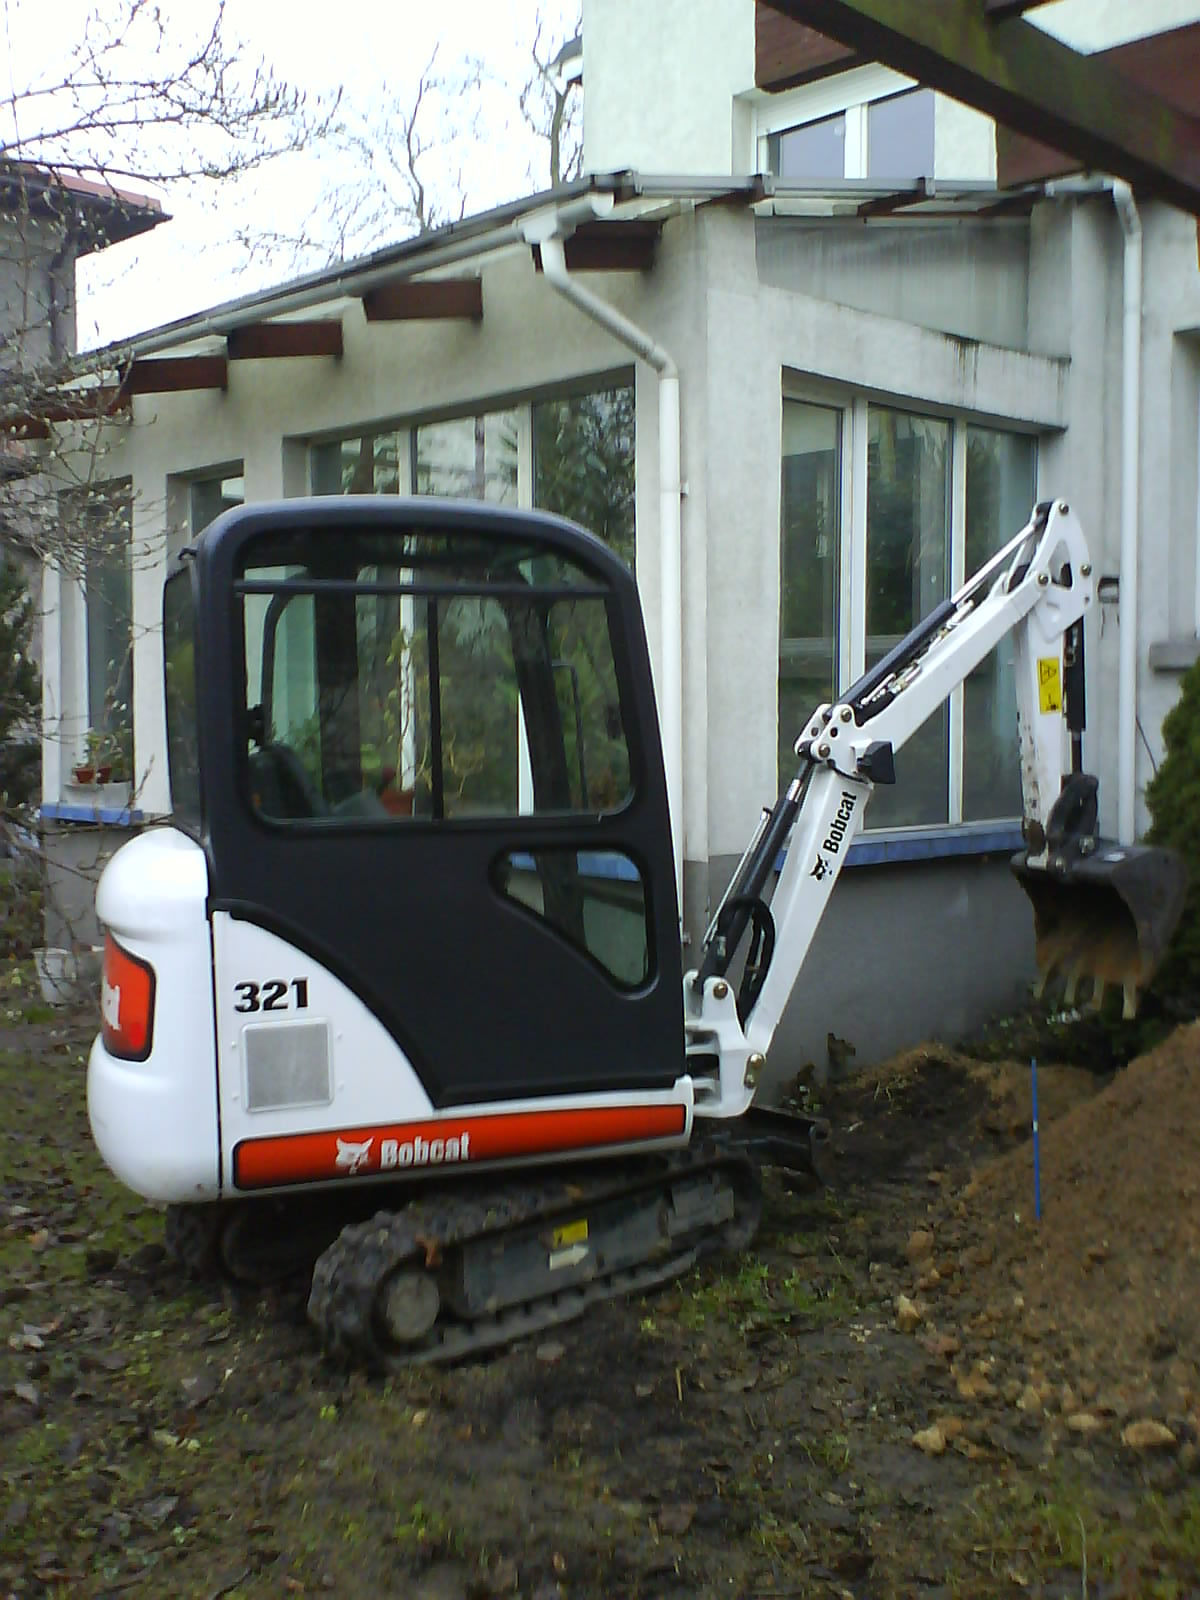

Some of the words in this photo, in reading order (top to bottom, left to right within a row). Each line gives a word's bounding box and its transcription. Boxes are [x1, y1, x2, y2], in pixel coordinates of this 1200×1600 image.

[823, 791, 857, 854] Bobcat
[234, 977, 308, 1013] 321
[380, 1131, 470, 1169] Bobcat
